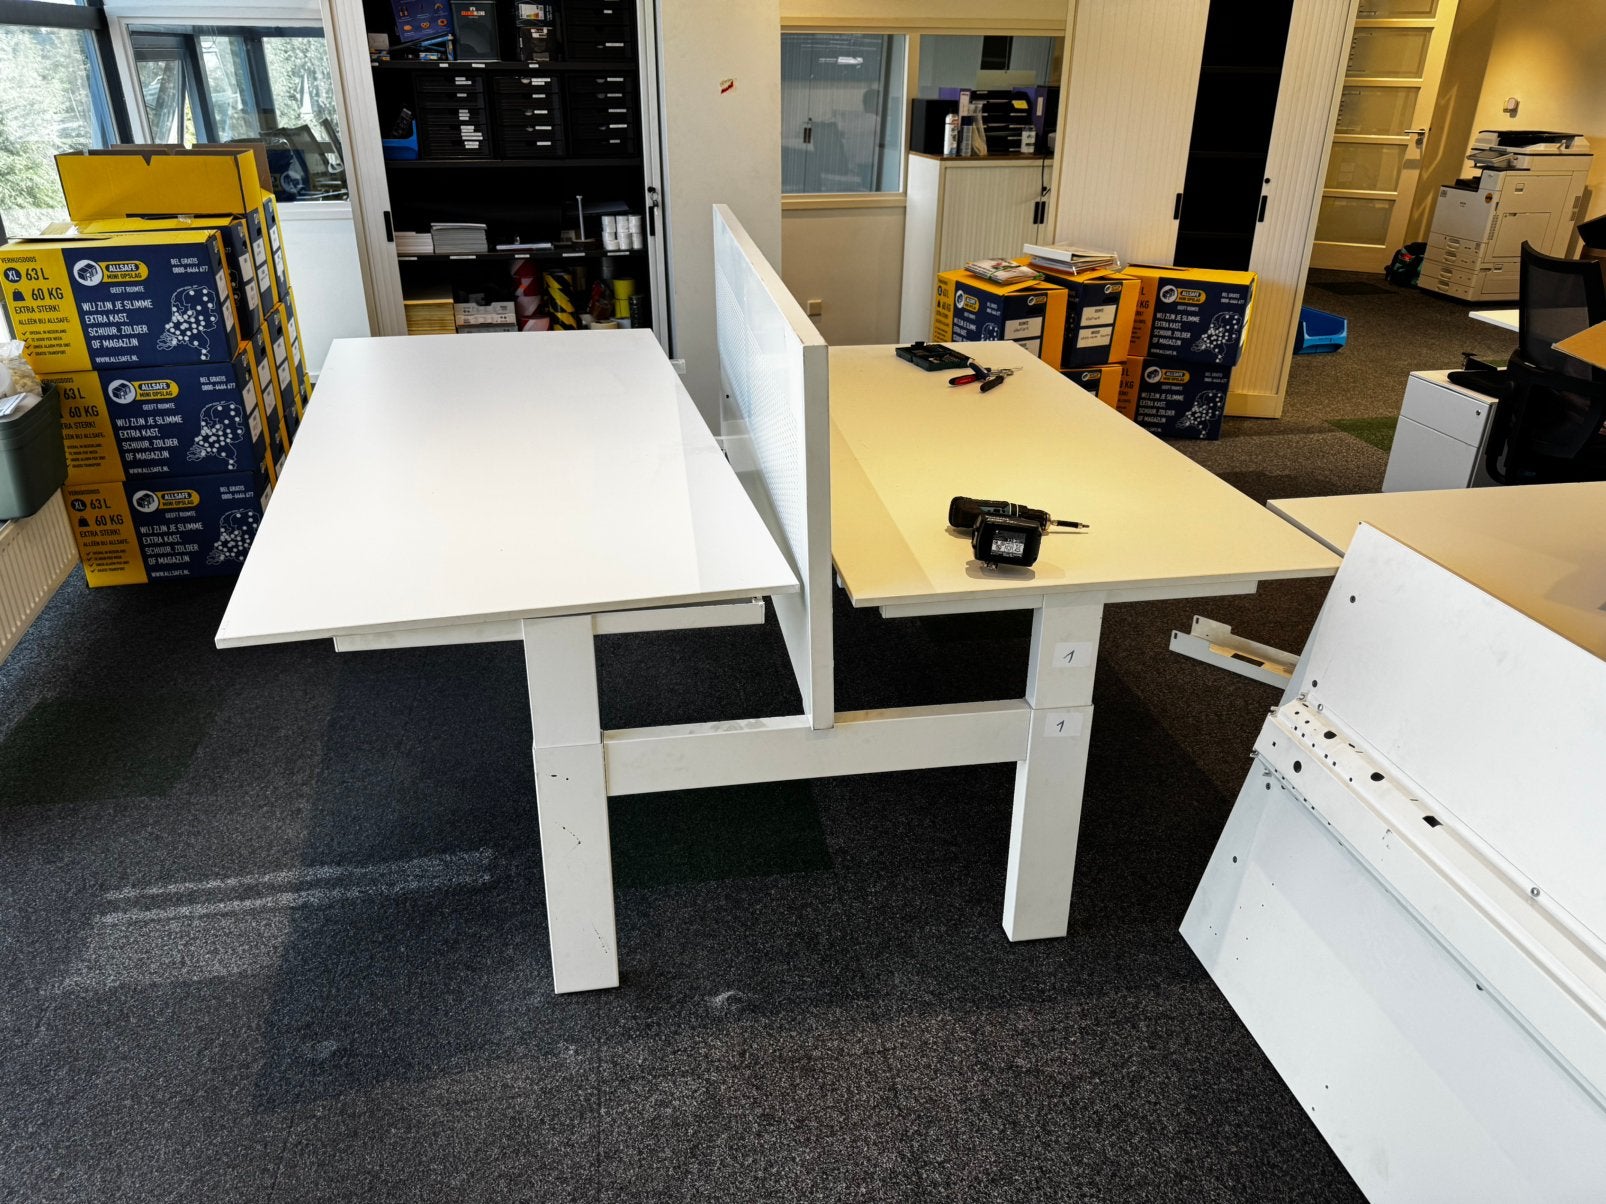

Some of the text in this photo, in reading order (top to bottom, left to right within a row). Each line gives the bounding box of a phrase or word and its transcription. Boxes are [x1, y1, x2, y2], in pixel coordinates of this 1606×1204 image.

[7, 270, 19, 280] XL
[26, 268, 49, 281] 63 L
[32, 287, 64, 300] 60 KG
[14, 306, 36, 314] EXTRA
[82, 300, 154, 311] WIJ ZIJN JE SLIMME
[85, 315, 108, 324] EXTRA
[121, 325, 148, 334] ZOLDER
[91, 338, 138, 349] OF MAGAZIJN
[64, 388, 85, 400] 63 L
[69, 406, 99, 418] 60 KG
[116, 418, 129, 427] WIJ
[130, 418, 146, 426] ZIJN
[156, 416, 183, 424] SLIMME
[119, 430, 140, 438] EXTRA
[153, 439, 178, 448] ZOLDER
[135, 451, 169, 460] MAGAZIJN
[74, 501, 84, 509] XL
[90, 498, 111, 510] 63 L
[95, 514, 123, 526] 60 KG
[178, 522, 203, 531] SLIMME
[175, 544, 199, 553] ZOLDER
[158, 555, 190, 564] MAGAZIJN
[1064, 650, 1075, 663] 1
[1057, 720, 1064, 732] 1
